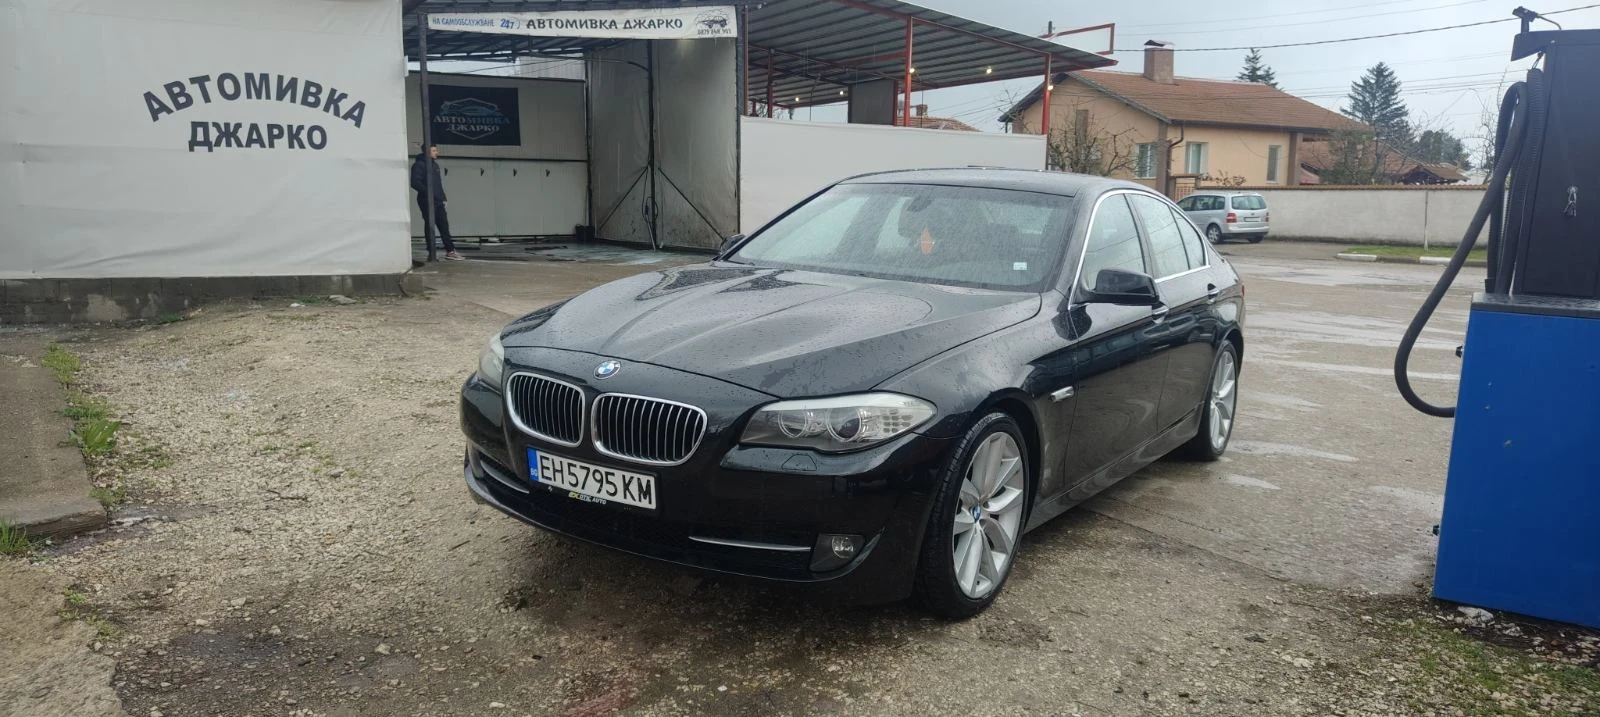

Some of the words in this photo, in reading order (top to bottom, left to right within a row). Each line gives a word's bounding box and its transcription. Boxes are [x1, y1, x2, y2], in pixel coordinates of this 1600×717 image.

[526, 17, 618, 30] АВТОМИВКА
[622, 17, 683, 30] ДЖАРКО
[143, 72, 366, 129] АВТОМИВКА
[433, 115, 510, 125] АВТОМИВКА
[446, 123, 500, 132] ДЖАРКО
[188, 121, 327, 152] ДЖАРКО
